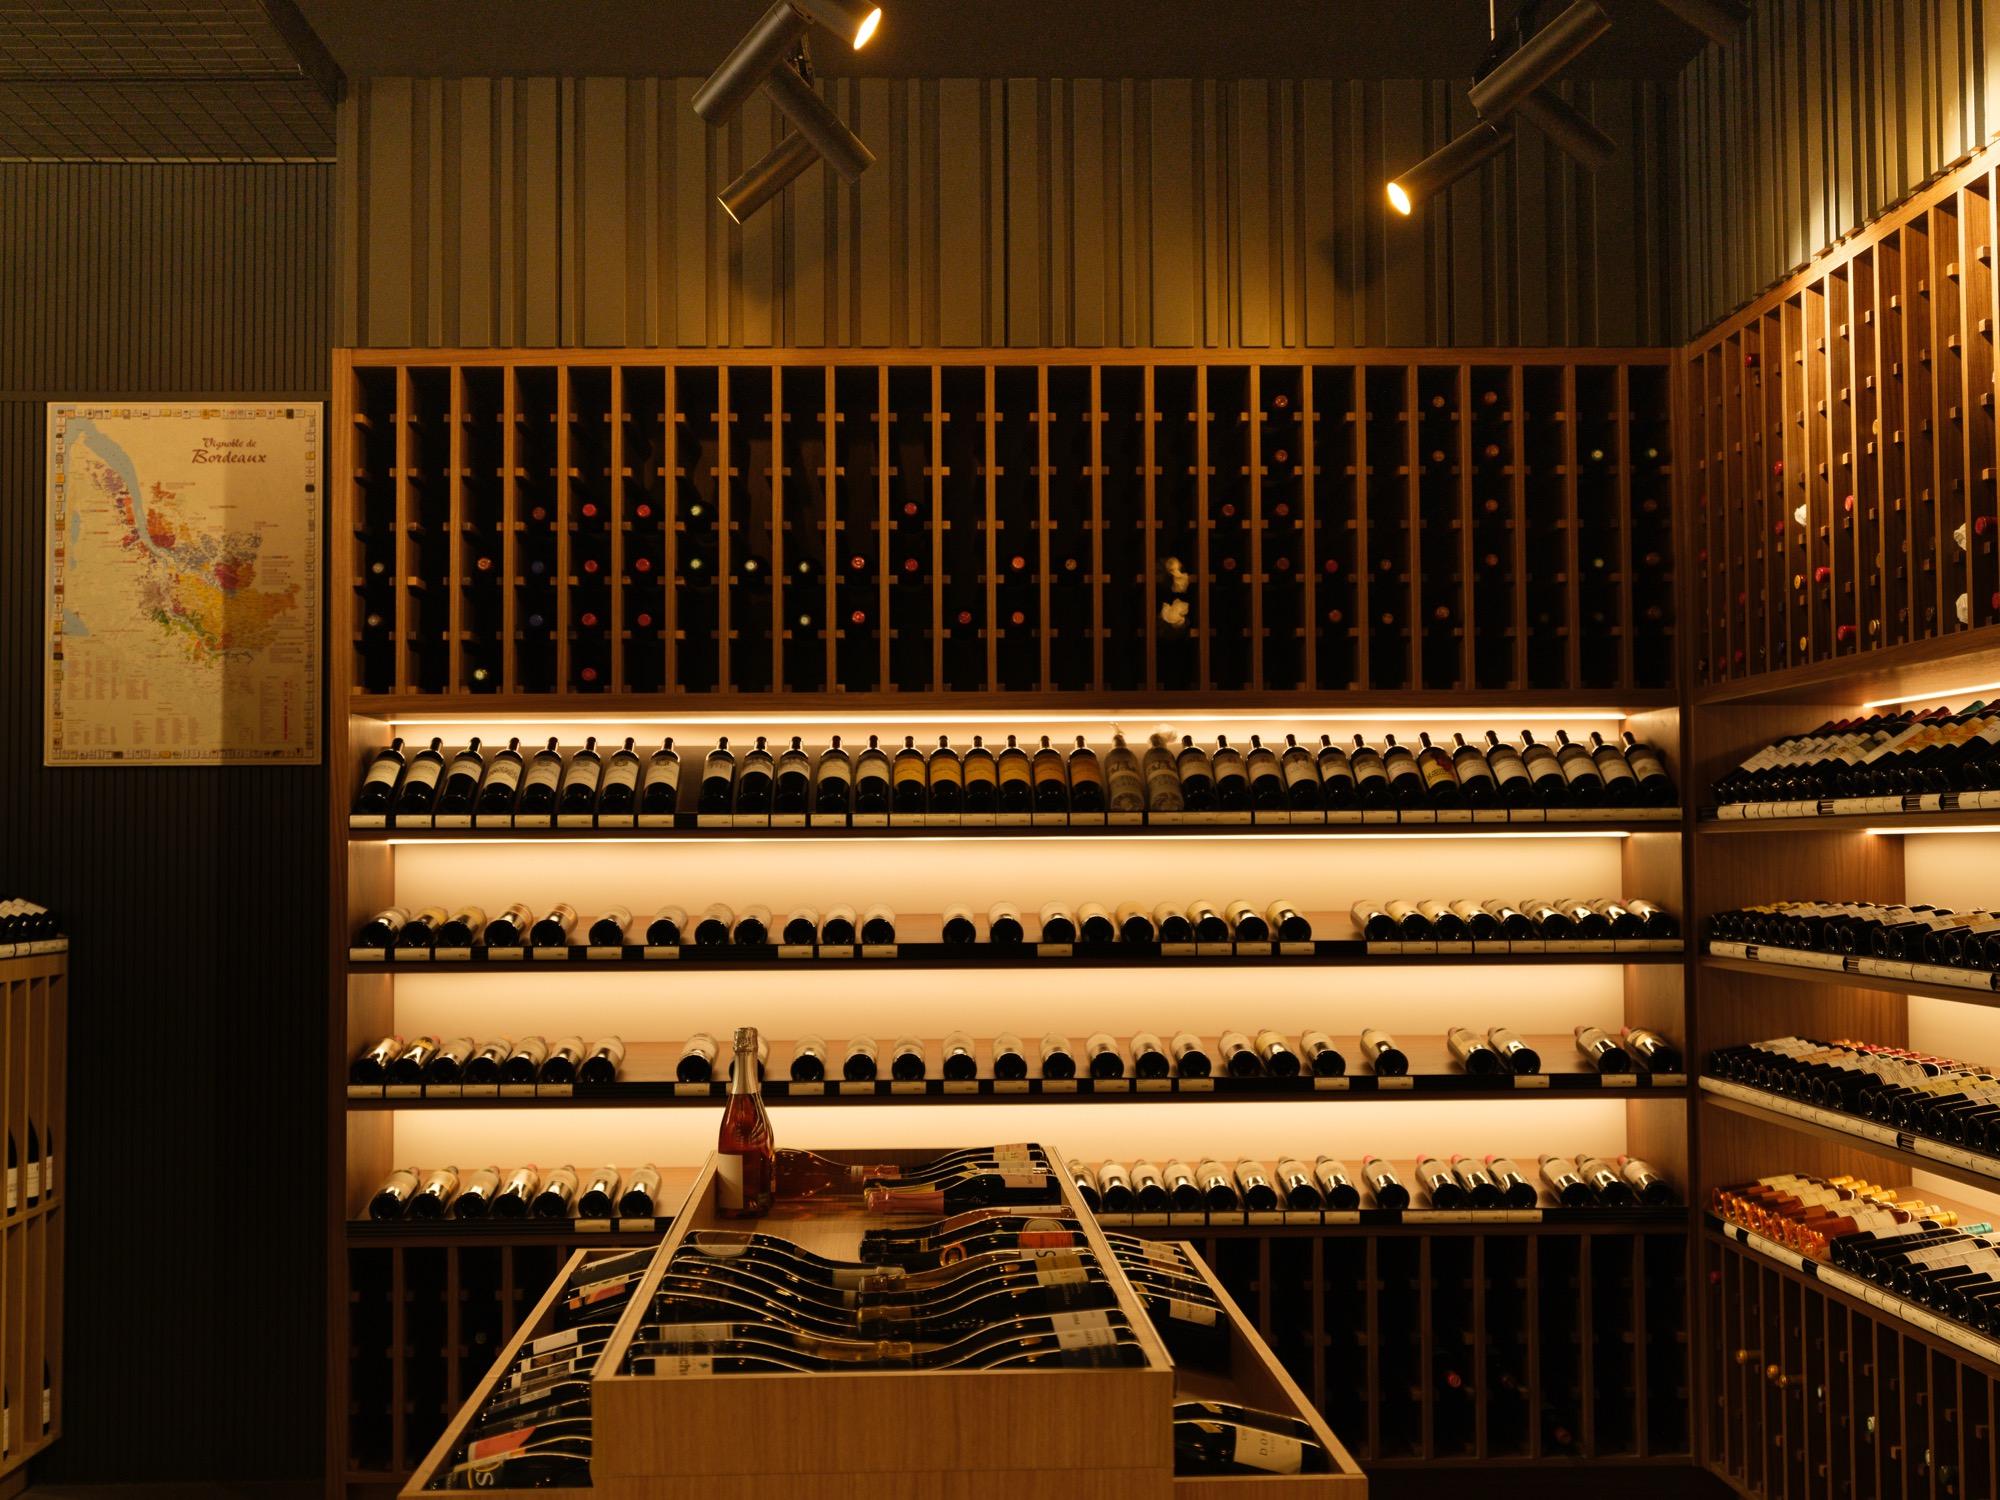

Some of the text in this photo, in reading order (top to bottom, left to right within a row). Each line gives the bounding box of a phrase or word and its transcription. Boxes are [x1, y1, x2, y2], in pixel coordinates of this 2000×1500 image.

[202, 437, 256, 450] Vignoble de
[192, 449, 267, 464] Bordeaux
